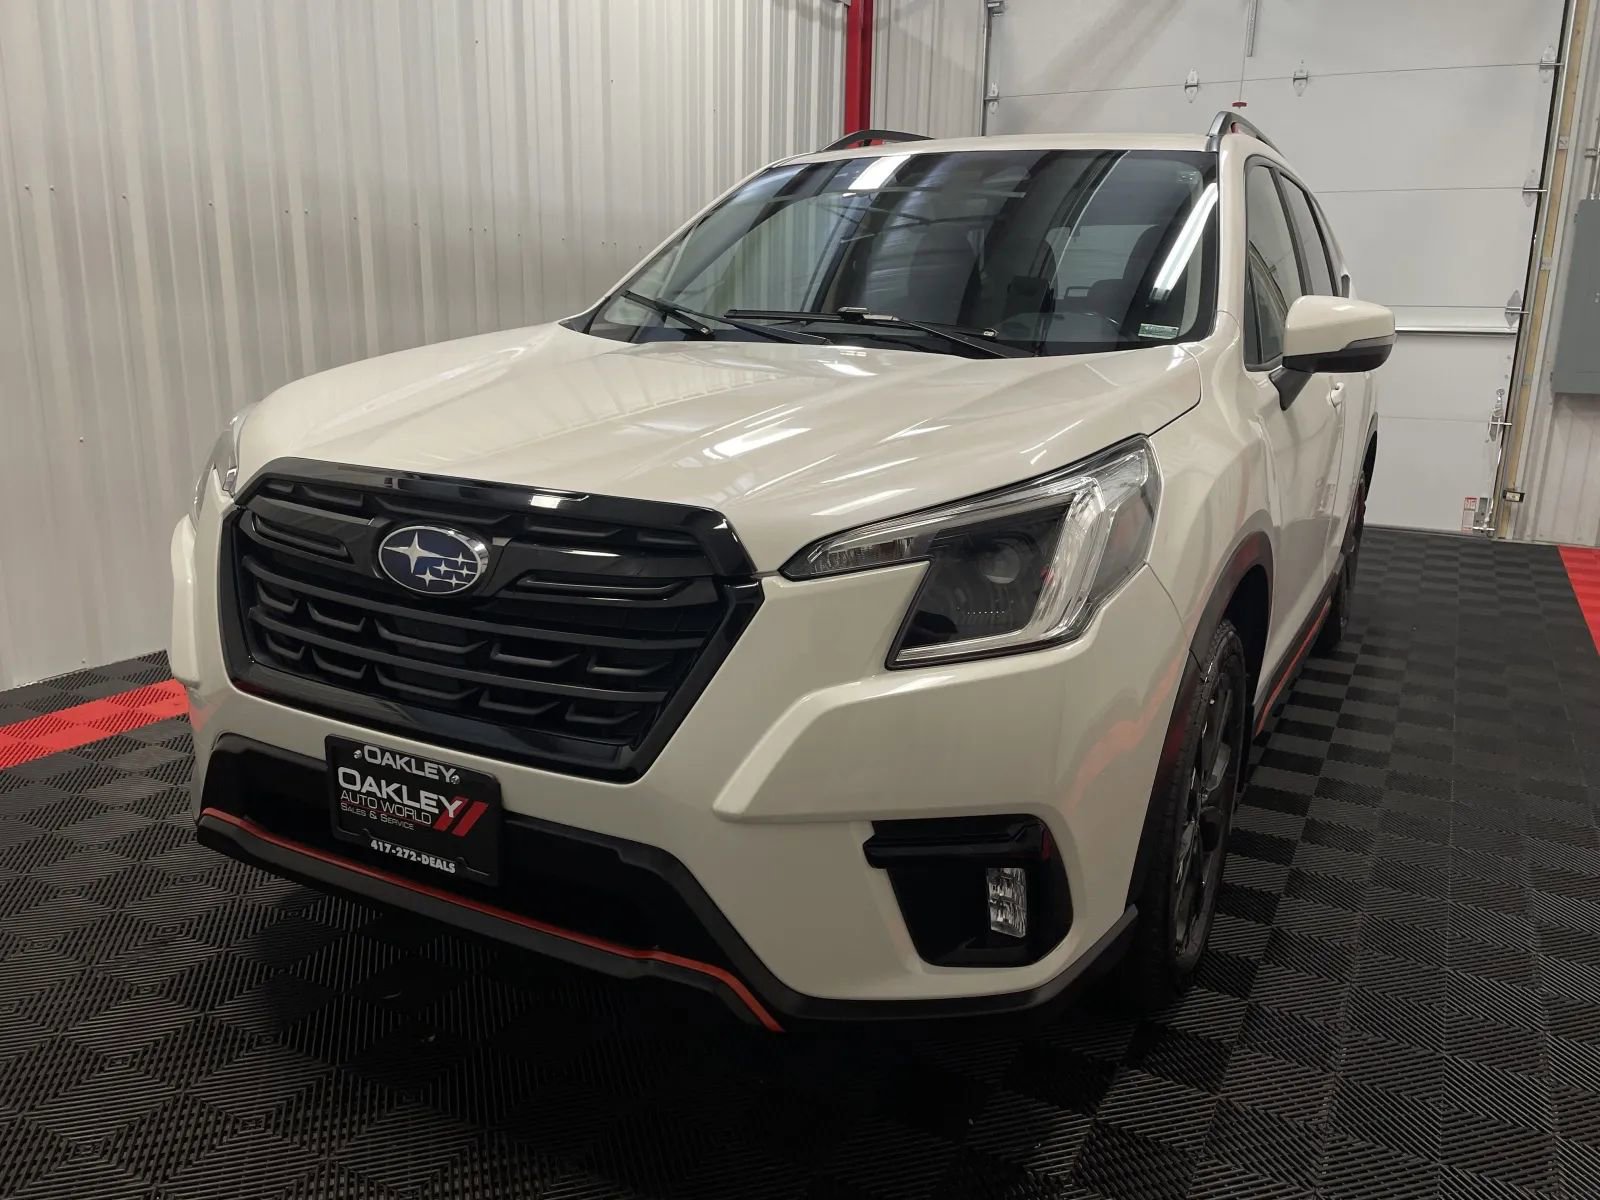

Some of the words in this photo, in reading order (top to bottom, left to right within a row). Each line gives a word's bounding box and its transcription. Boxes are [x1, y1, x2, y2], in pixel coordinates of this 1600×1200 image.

[363, 744, 456, 783] OAKLEY
[337, 766, 463, 818] OAKLEY
[340, 790, 378, 809] AUTO
[381, 801, 432, 825] WORLD
[369, 810, 378, 820] &
[370, 839, 457, 874] 417-272-DEALS
